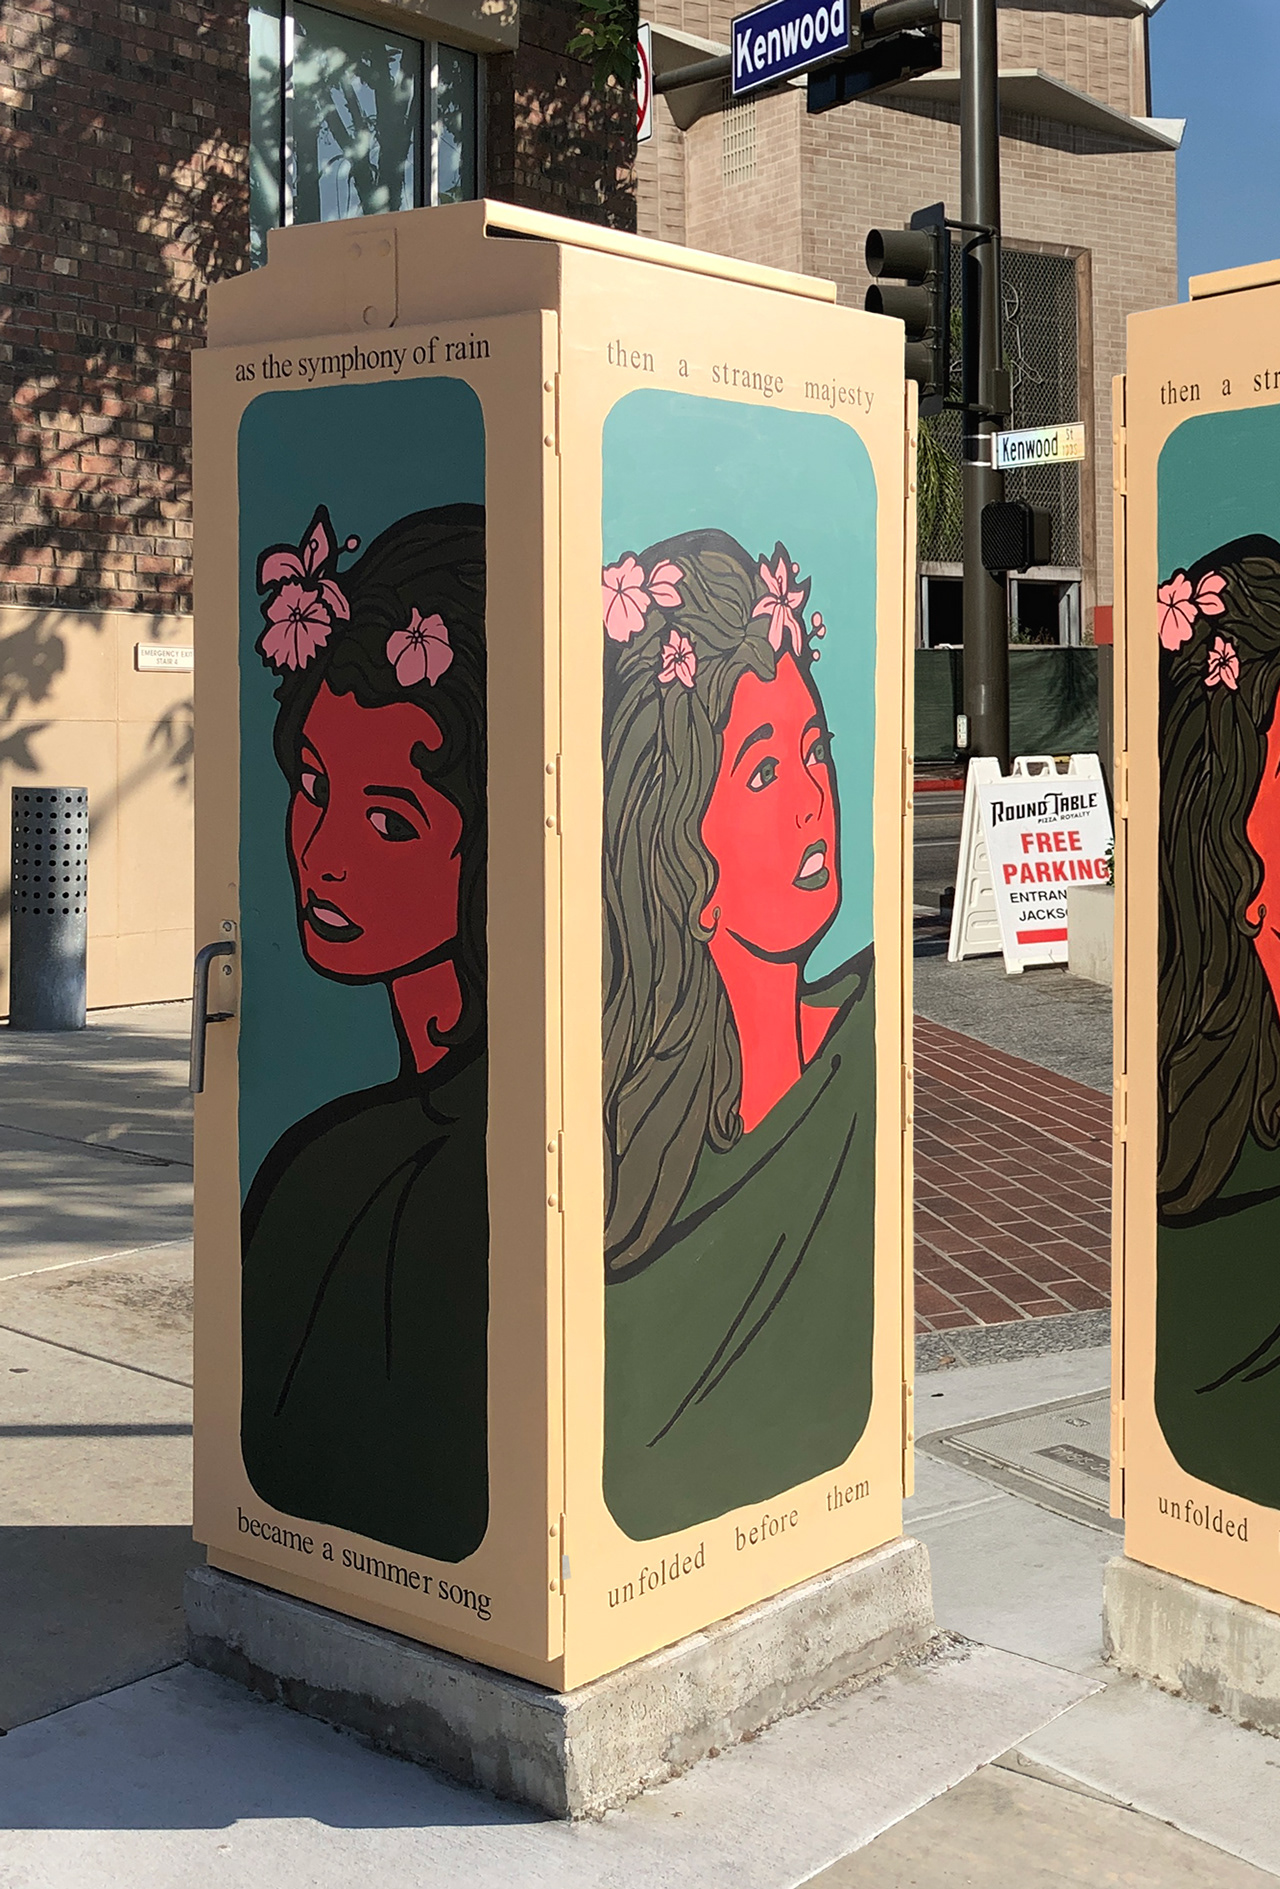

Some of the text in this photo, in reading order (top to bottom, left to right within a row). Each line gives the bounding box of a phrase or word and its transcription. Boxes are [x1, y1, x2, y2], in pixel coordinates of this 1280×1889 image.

[737, 0, 845, 78] Kenwood
[235, 333, 491, 382] as the symphony of rain
[607, 339, 875, 414] then a strange majesty
[1160, 380, 1201, 406] then
[1222, 378, 1232, 396] a
[1002, 428, 1073, 462] Kenwood St
[1060, 811, 1090, 820] ROYALTY
[1021, 830, 1082, 854] FREE
[1002, 858, 1110, 884] PARKING
[1019, 908, 1068, 921] JACKS
[1158, 1496, 1248, 1542] unfolded
[607, 1480, 870, 1607] unfolded before them
[237, 1507, 492, 1621] became a summer song
